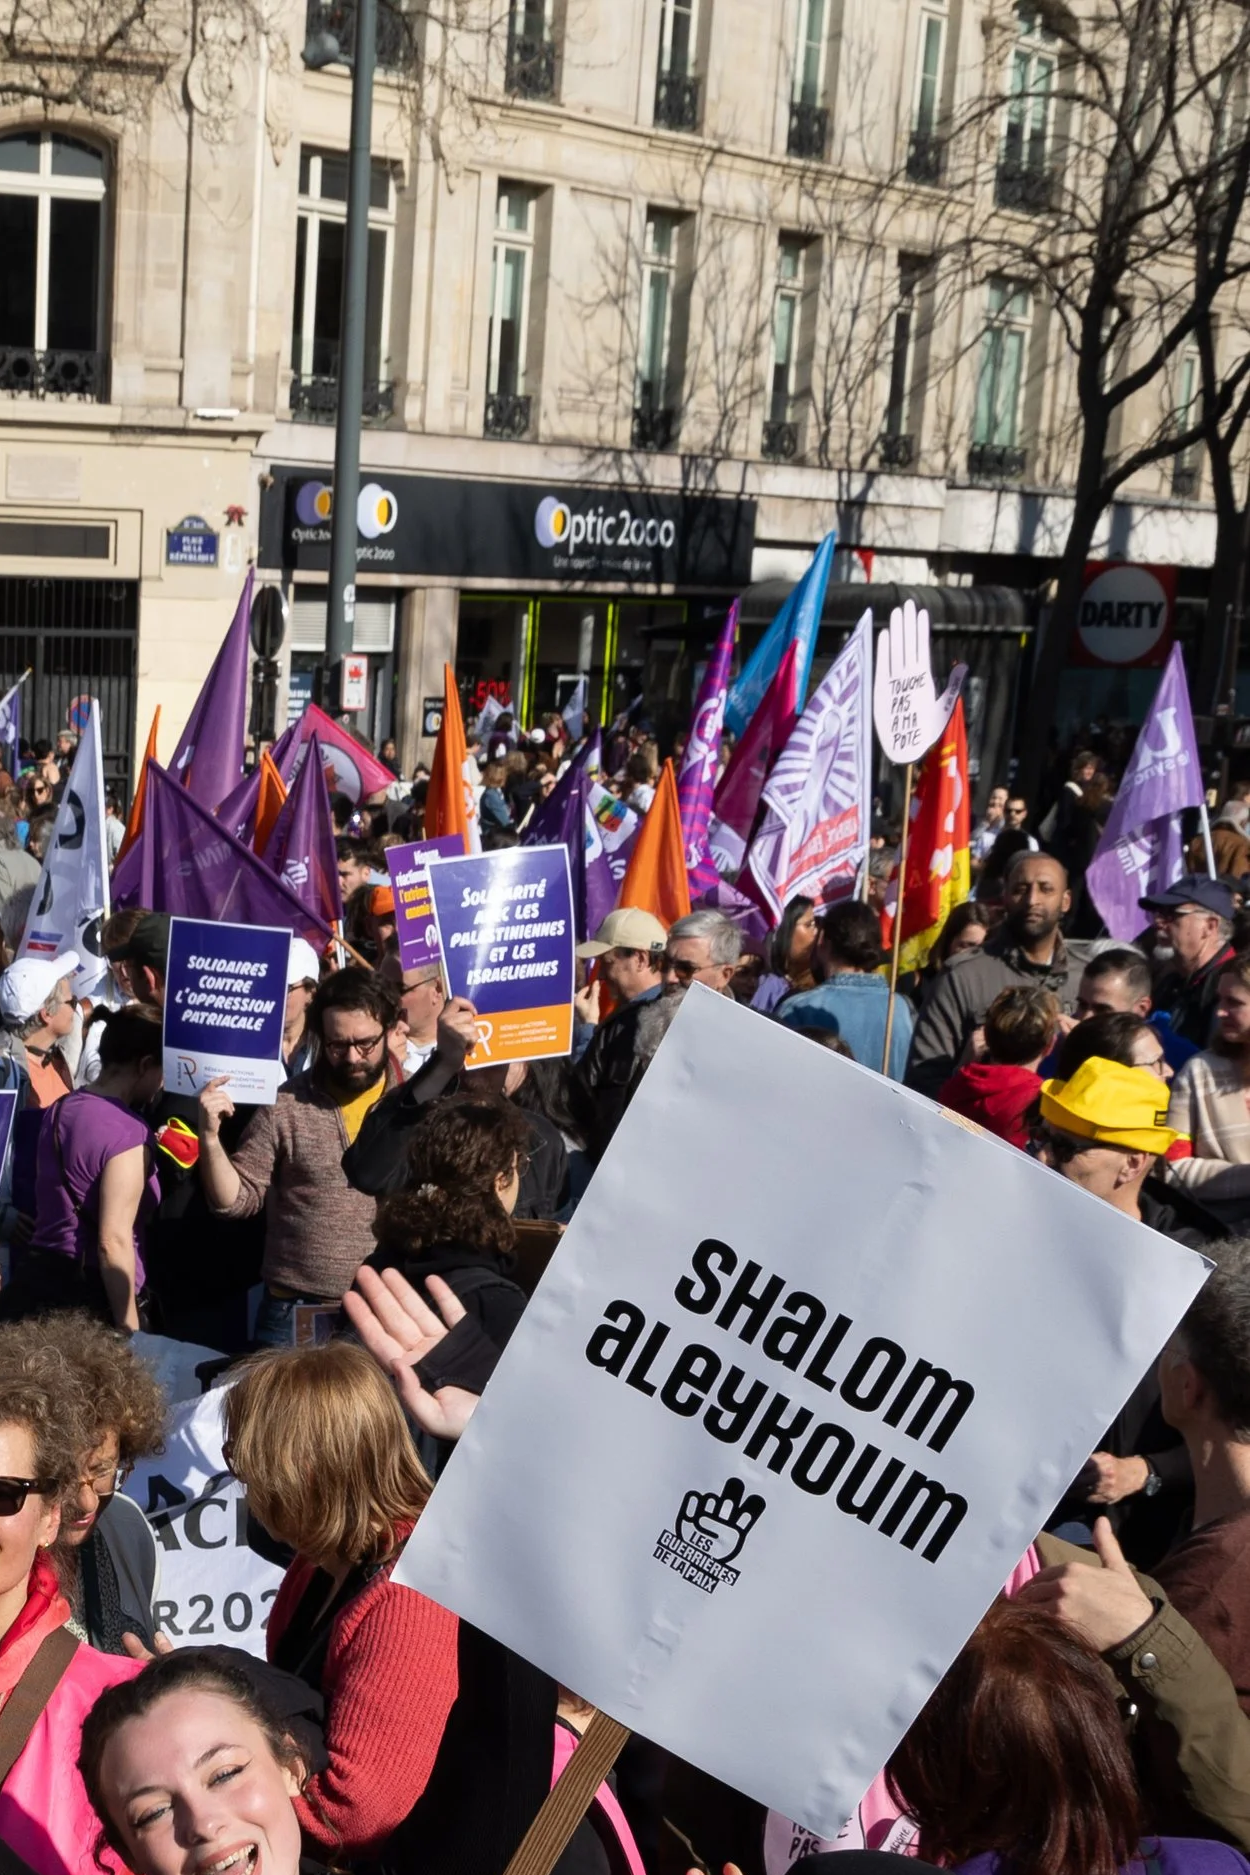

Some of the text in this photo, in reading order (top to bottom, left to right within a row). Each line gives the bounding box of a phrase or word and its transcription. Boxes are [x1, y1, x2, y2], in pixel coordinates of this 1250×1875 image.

[1081, 600, 1164, 629] DARTY
[889, 672, 927, 694] TOUCHE
[891, 695, 911, 715] PAS
[891, 715, 899, 733] A
[892, 730, 922, 752] POTE
[515, 902, 540, 919] LES
[450, 920, 565, 948] PALESTINIENNES
[489, 943, 536, 962] ET LES
[187, 955, 268, 977] SOLIDAIRES
[467, 961, 558, 985] ISRAELIENNES
[199, 975, 253, 994] CONTRE
[175, 988, 276, 1014] L'OPPRESSION
[181, 1010, 265, 1032] PATRIACALE
[689, 1531, 713, 1552] LES
[653, 1546, 717, 1593] DE LA PAIX
[660, 1532, 737, 1585] GUERRIÈRES
[789, 1837, 821, 1861] PAS
